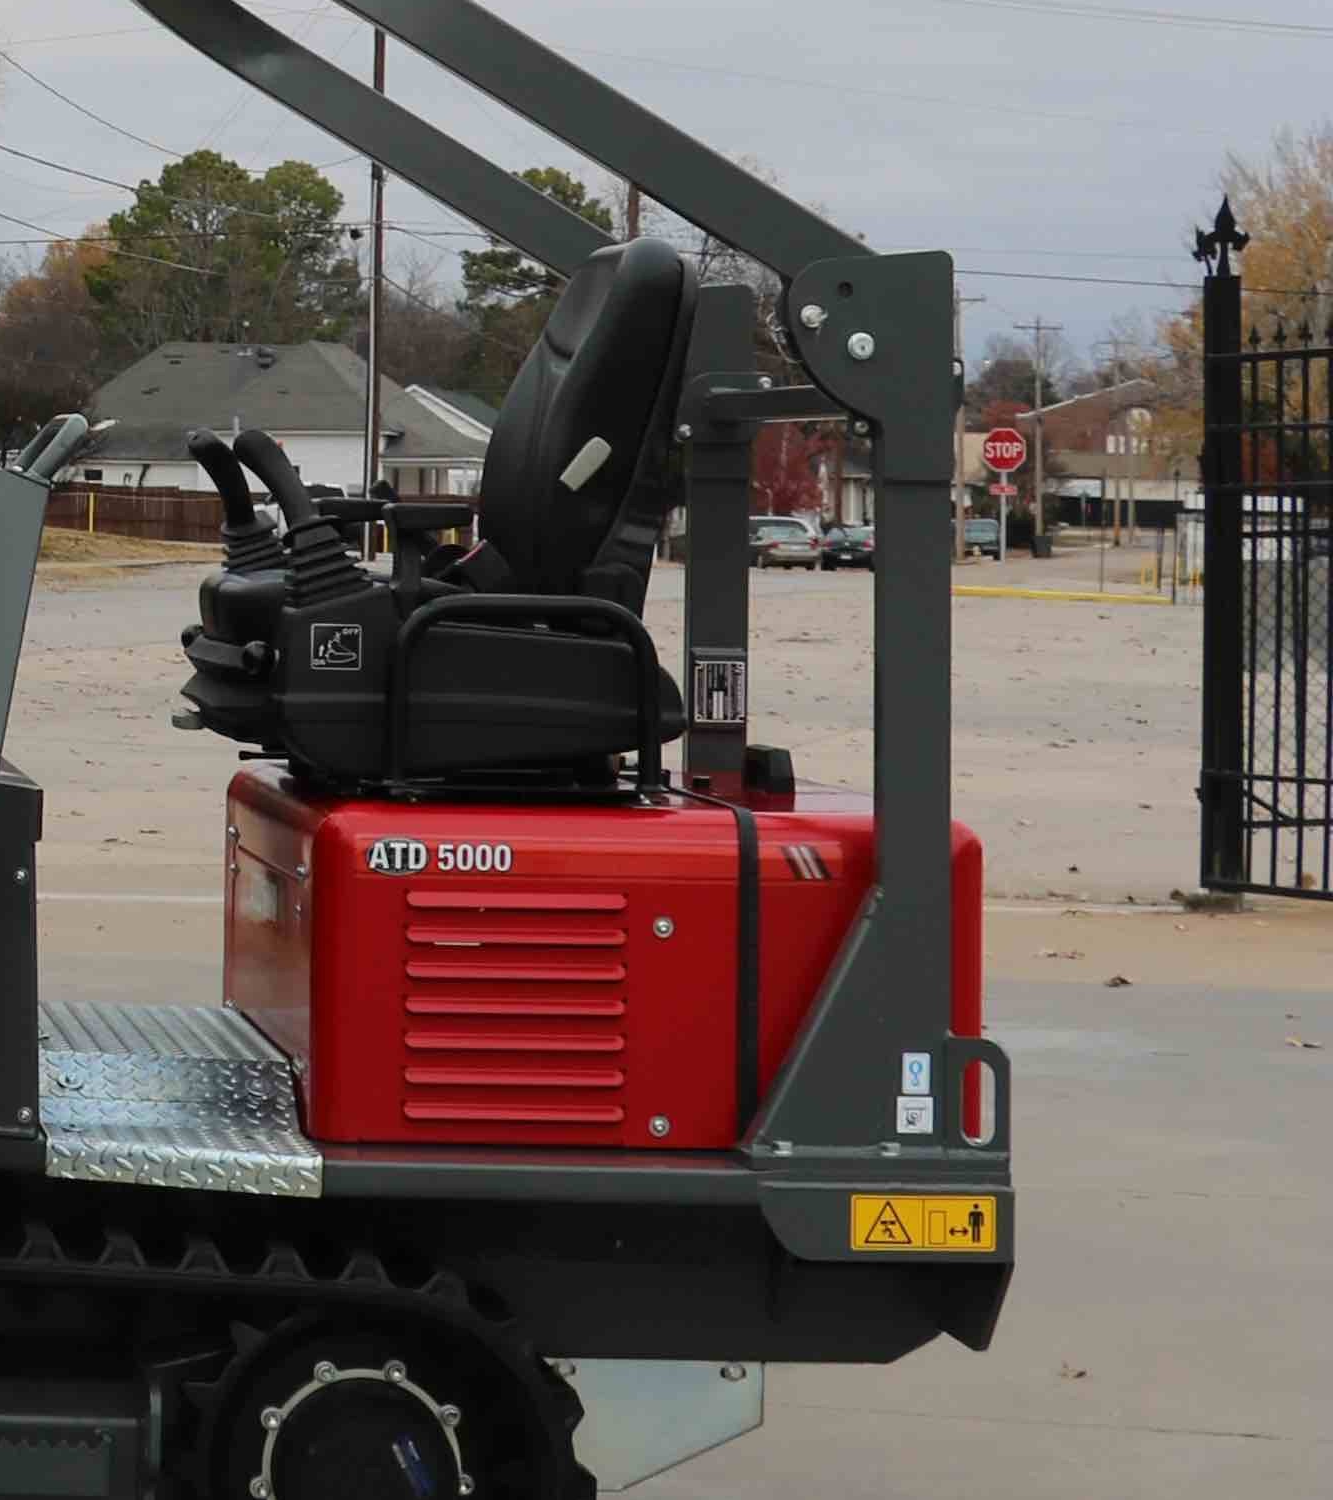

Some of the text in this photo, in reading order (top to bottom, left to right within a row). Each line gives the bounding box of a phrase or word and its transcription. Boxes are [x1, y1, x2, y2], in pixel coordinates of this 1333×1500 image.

[985, 442, 1022, 458] STOP
[368, 841, 512, 872] ATD 5000
